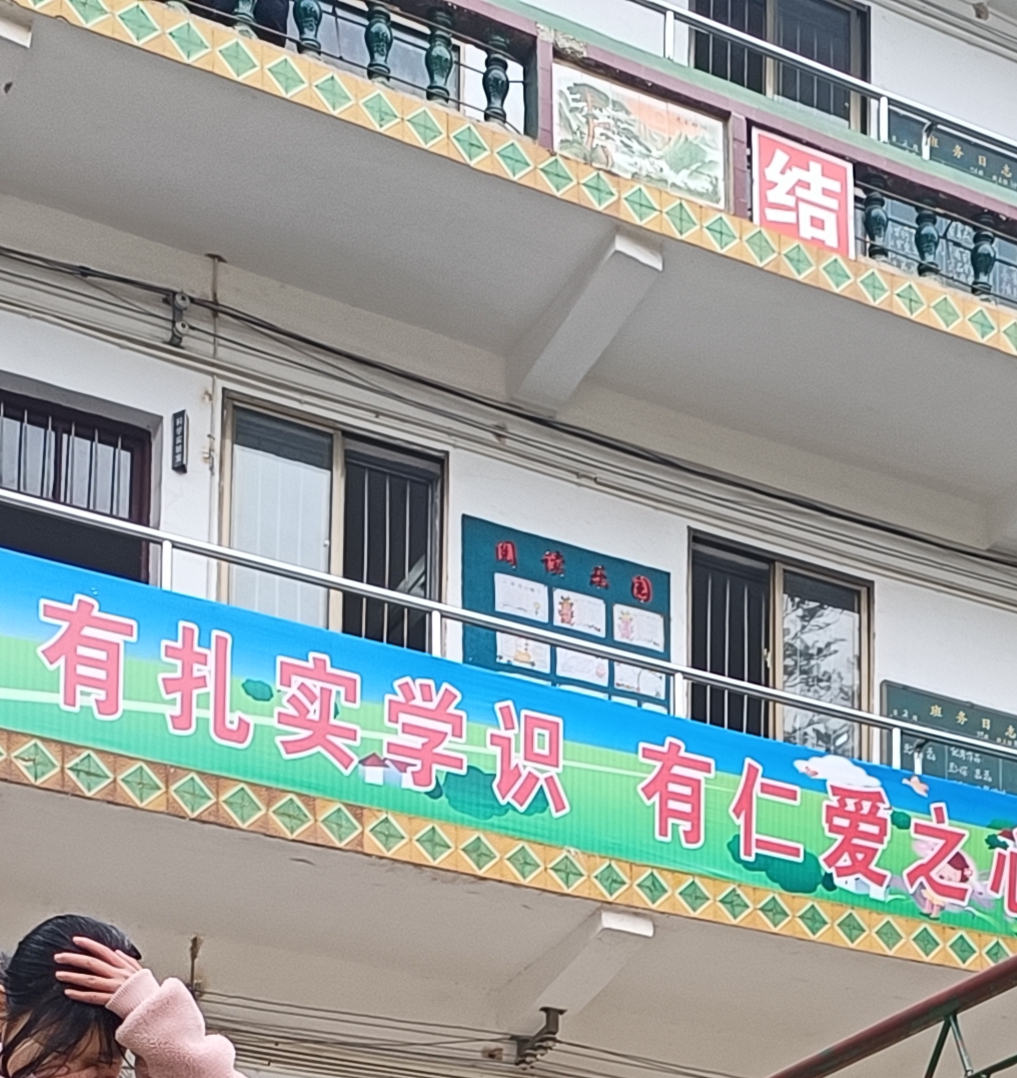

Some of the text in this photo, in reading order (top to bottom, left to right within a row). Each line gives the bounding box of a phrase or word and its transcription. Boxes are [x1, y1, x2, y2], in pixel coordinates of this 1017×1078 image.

[763, 148, 842, 249] 结
[40, 594, 569, 816] 有扎实学识
